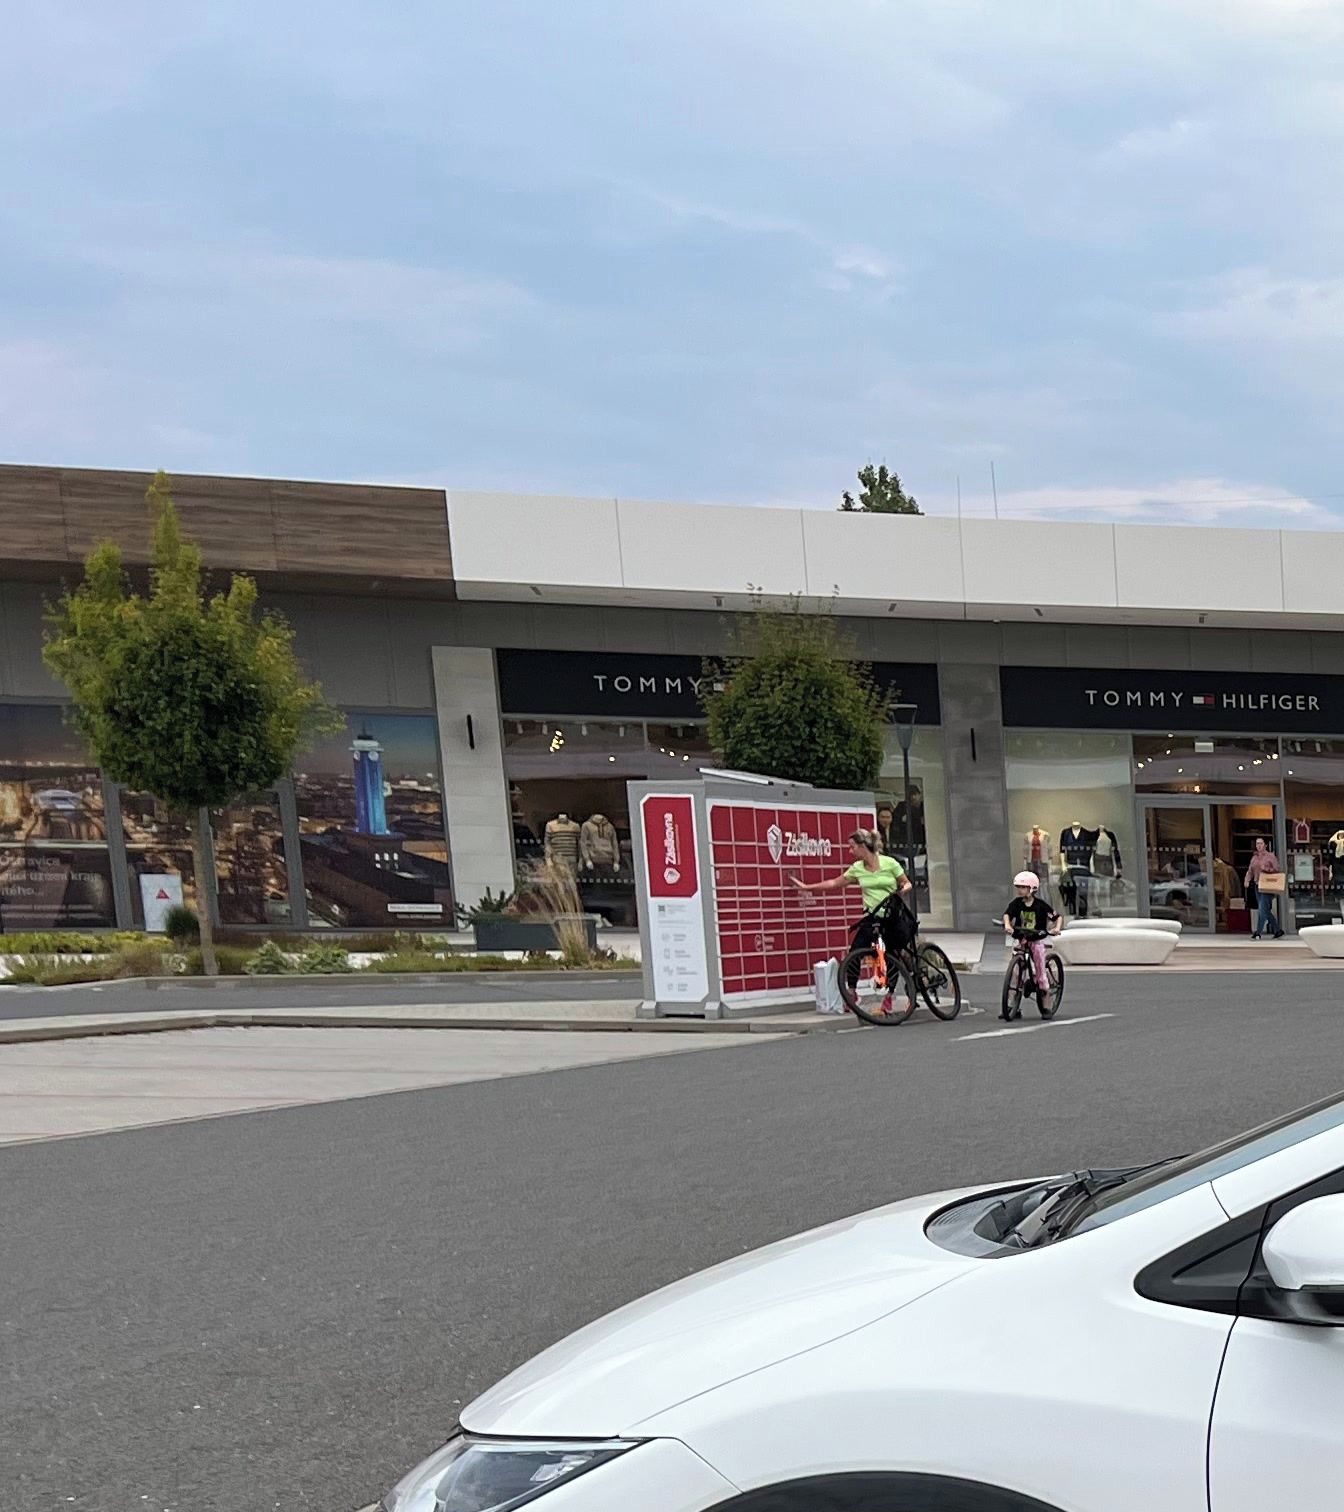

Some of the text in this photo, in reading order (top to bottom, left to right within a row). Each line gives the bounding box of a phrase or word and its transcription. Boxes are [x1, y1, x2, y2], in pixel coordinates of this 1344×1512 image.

[593, 674, 702, 695] TOMMY
[1085, 690, 1320, 711] TOMMY HILFIGER
